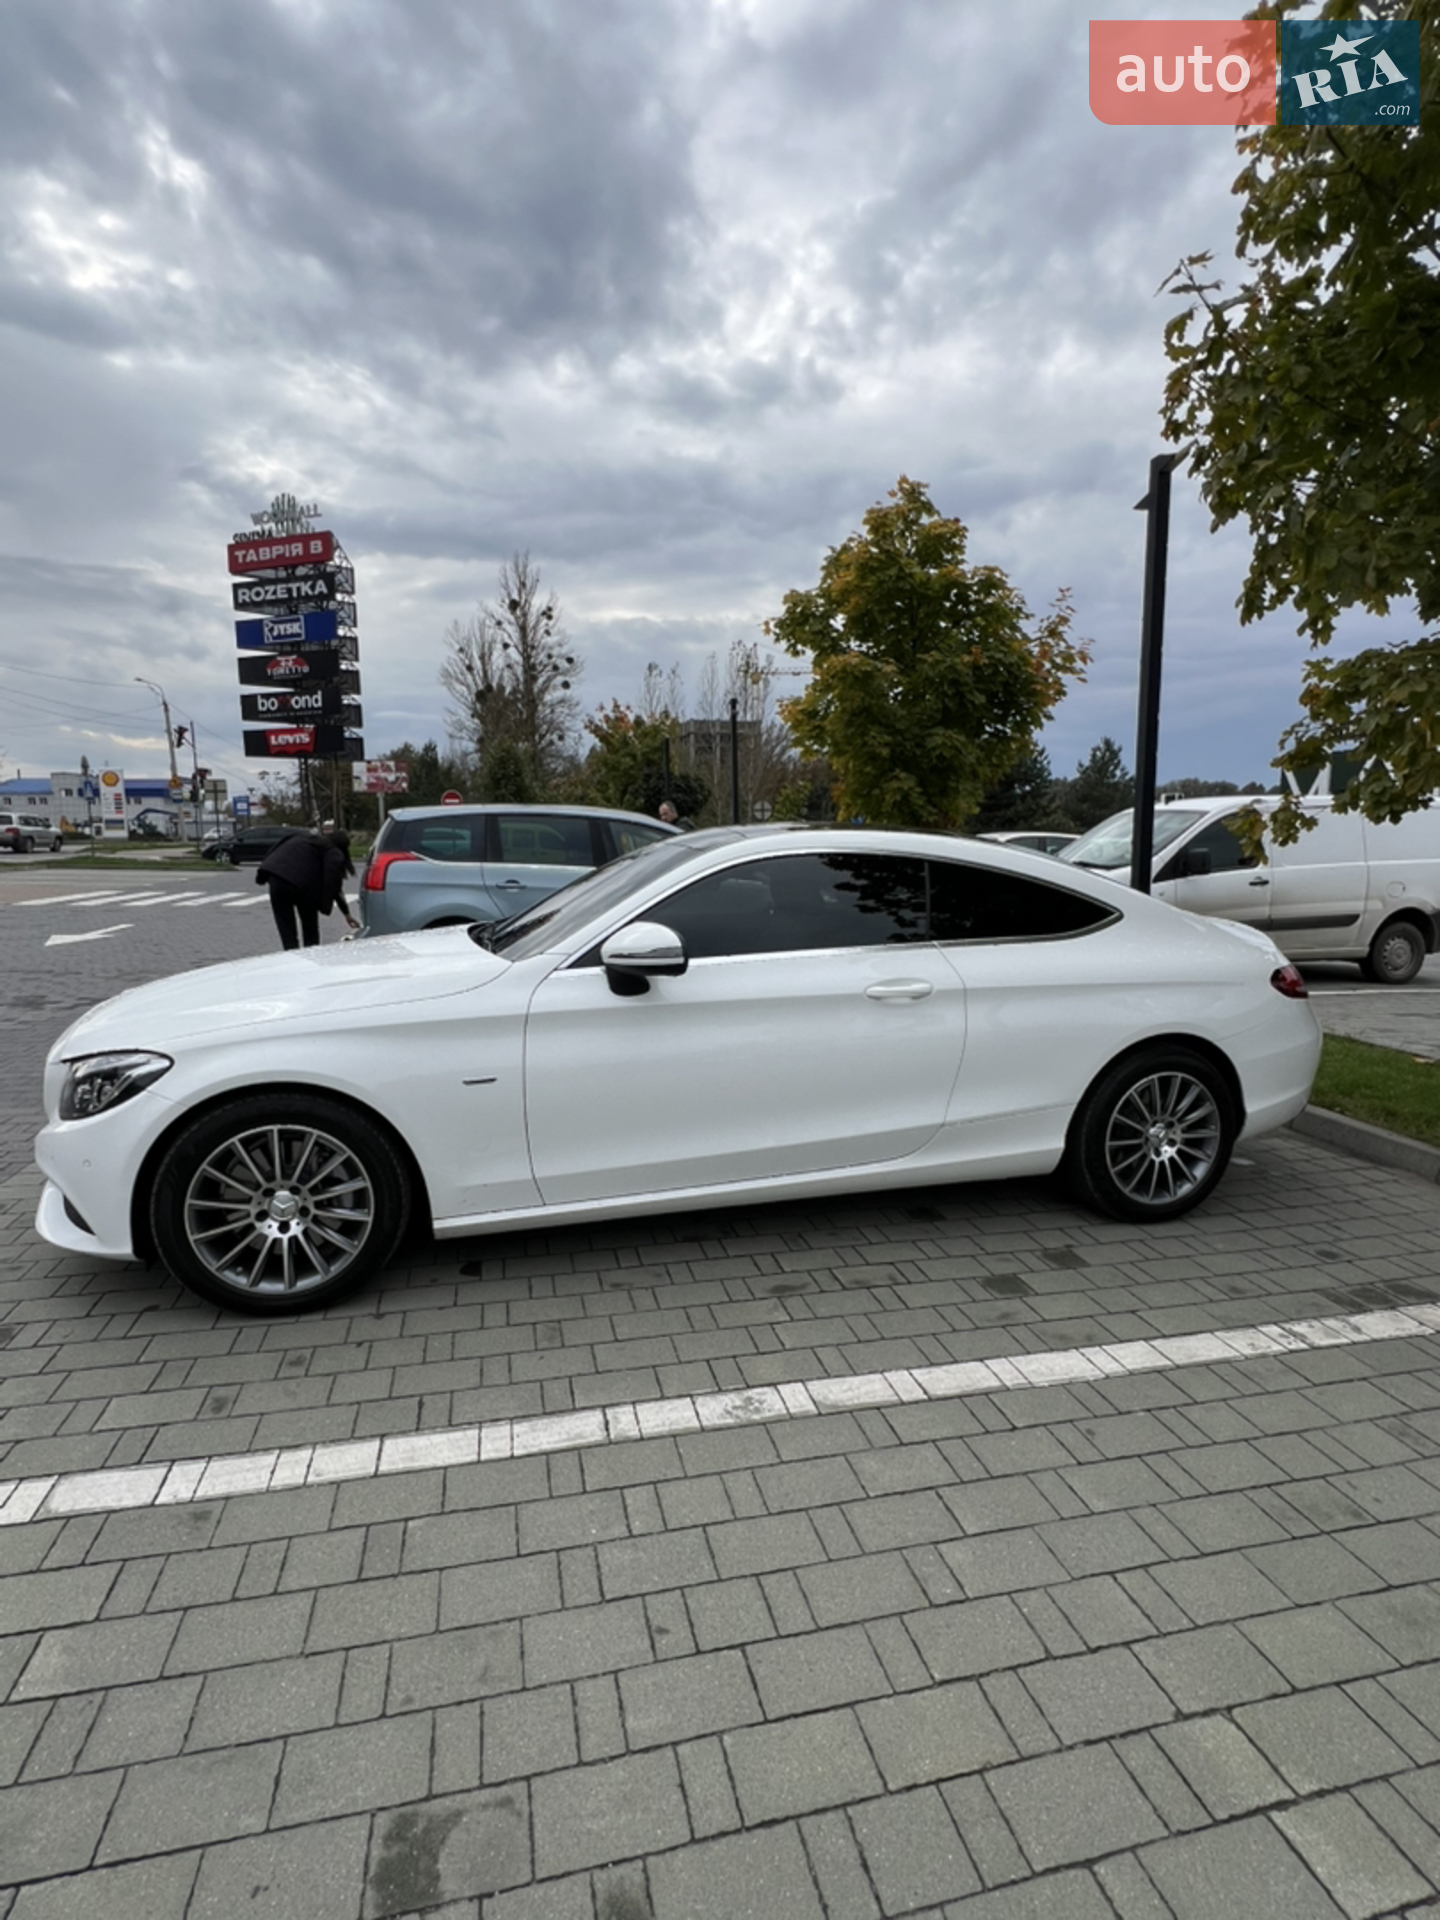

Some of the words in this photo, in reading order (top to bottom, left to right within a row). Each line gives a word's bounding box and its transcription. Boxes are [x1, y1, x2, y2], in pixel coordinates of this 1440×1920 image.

[234, 542, 303, 563] ТАВРІЯ
[310, 540, 323, 554] В
[237, 579, 328, 604] ROZETKA
[272, 621, 303, 636] JYSK
